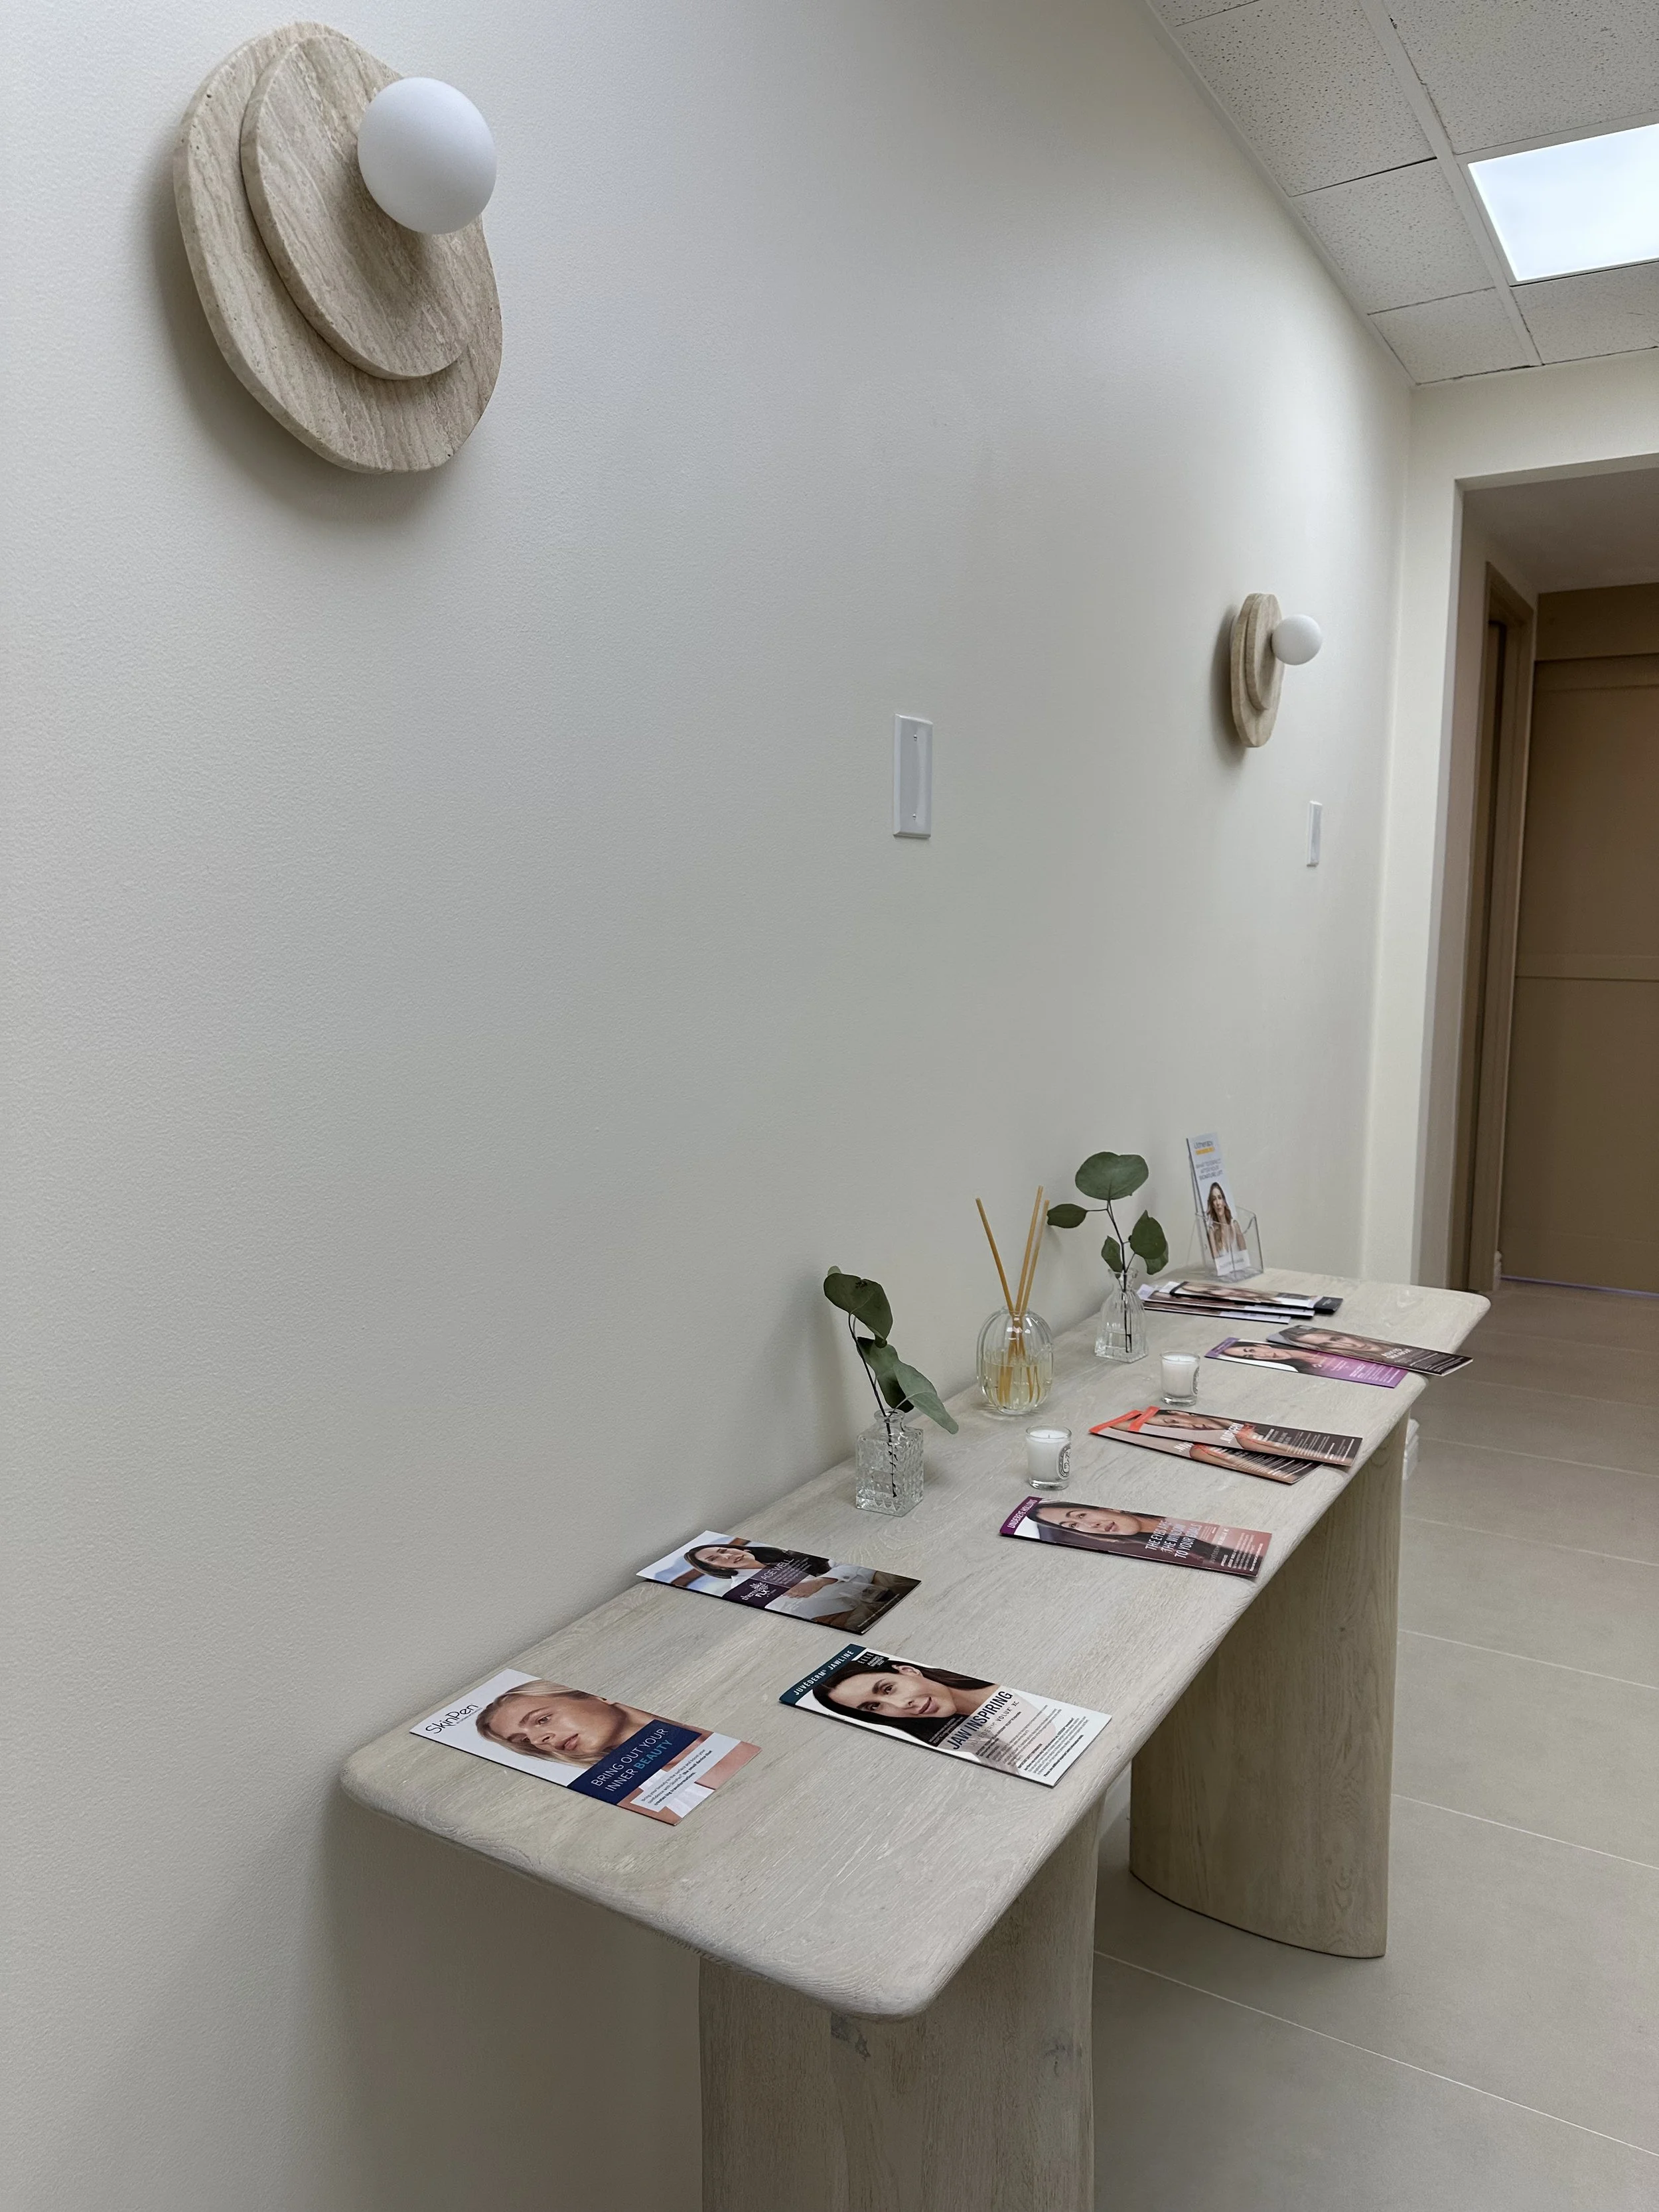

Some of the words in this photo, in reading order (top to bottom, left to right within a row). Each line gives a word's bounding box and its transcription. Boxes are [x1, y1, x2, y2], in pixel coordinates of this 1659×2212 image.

[1151, 1528, 1167, 1542] EYES
[1145, 1538, 1161, 1551] THE
[1161, 1540, 1177, 1553] THE
[1178, 1536, 1194, 1551] YOUR
[1175, 1550, 1189, 1558] TO
[760, 1570, 777, 1580] AGE
[772, 1558, 795, 1571] WELL
[755, 1589, 770, 1597] FLX
[828, 1650, 854, 1670] JAWLINE
[857, 1653, 875, 1664] ELLE
[425, 1704, 479, 1734] SkinPen
[947, 1728, 972, 1750] JAW
[969, 1691, 1013, 1732] INSPIRING
[591, 1763, 624, 1787] BRING
[620, 1747, 643, 1763] OUT
[639, 1728, 669, 1747] YOUR
[605, 1769, 638, 1792] INNER
[633, 1739, 673, 1769] BEAUTY
